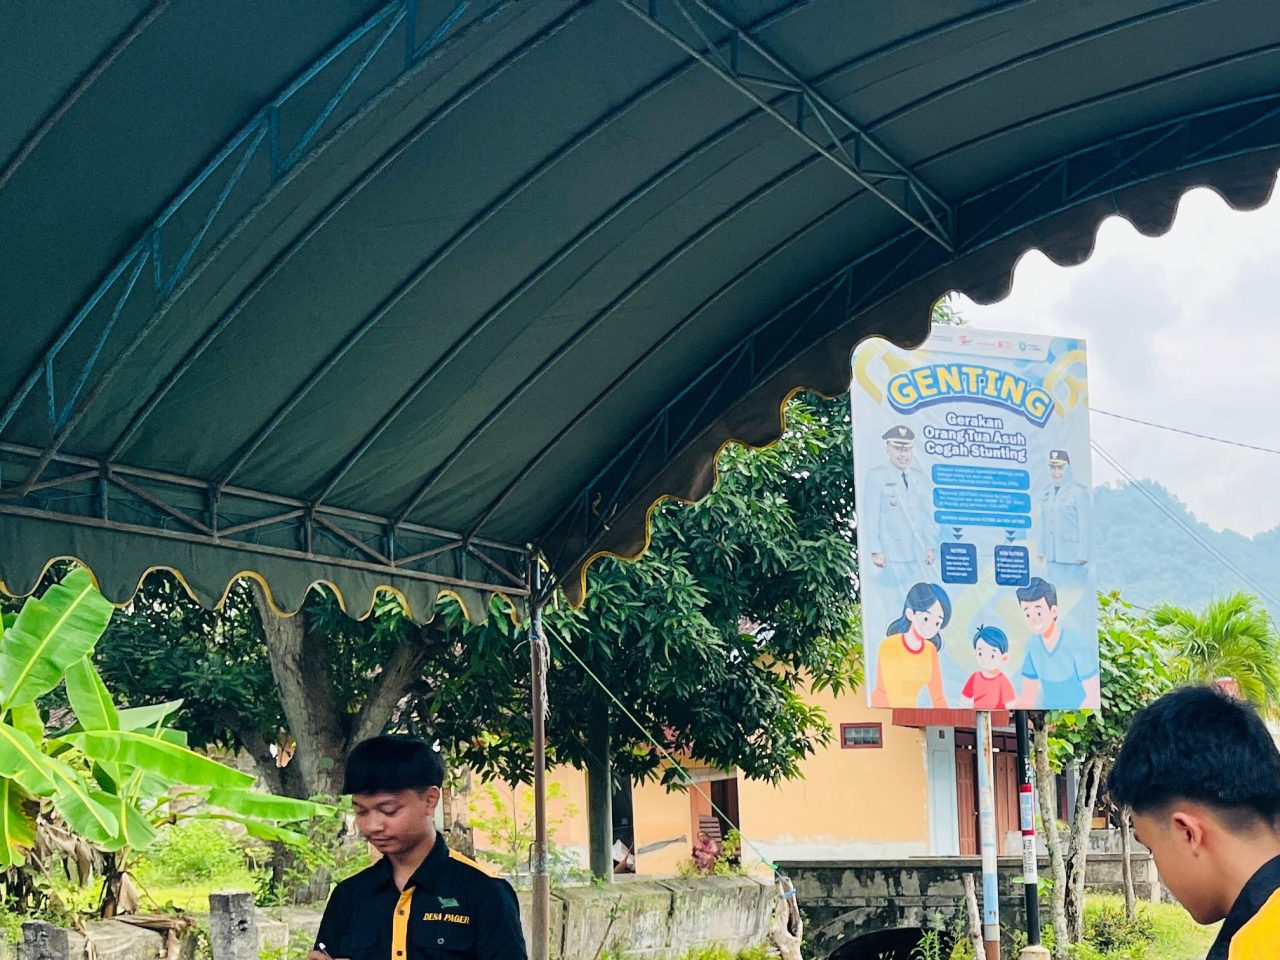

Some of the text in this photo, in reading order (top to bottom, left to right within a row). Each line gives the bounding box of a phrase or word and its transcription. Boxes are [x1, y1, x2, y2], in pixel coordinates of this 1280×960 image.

[889, 364, 1052, 421] GENTING
[946, 412, 1003, 429] Gerakan
[924, 426, 1026, 446] Orang Tua Asuh
[925, 441, 1027, 463] Cegah Stunting
[423, 912, 470, 924] DESA PAGER
